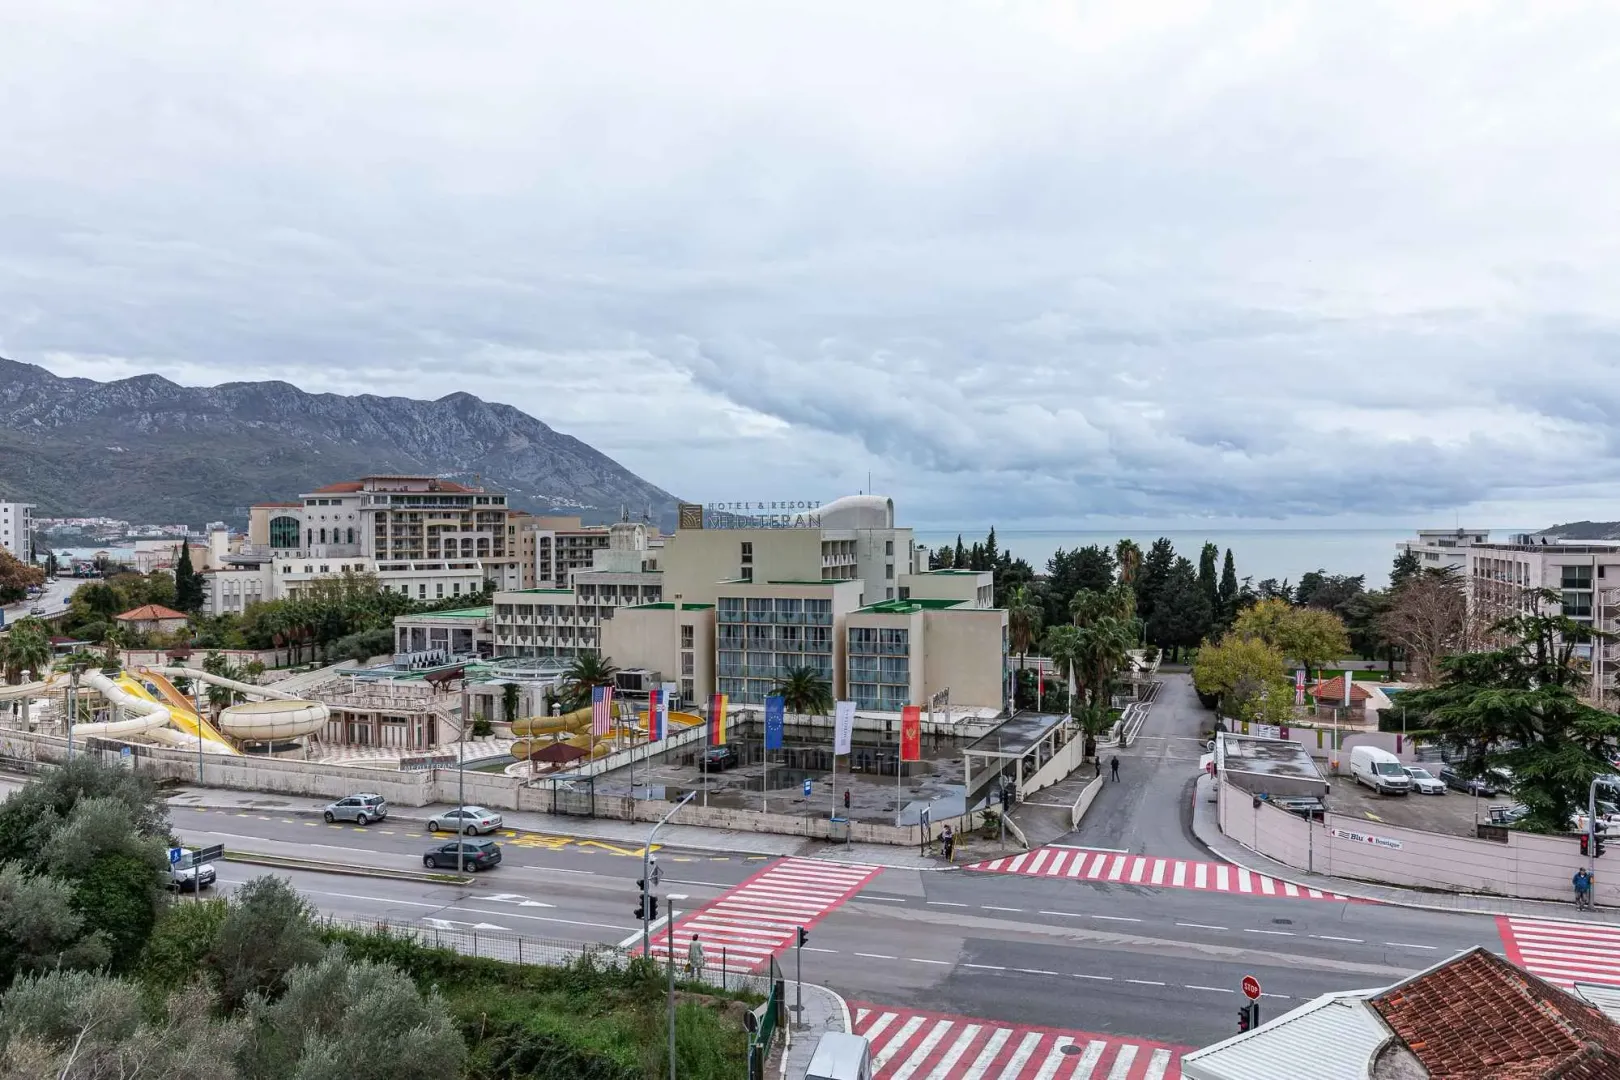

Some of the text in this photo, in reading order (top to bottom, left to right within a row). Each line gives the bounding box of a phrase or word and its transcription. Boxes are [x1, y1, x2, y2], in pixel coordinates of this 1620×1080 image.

[708, 500, 820, 510] HOTEL & RESORT
[709, 514, 821, 528] MEDITERAN
[1350, 833, 1364, 842] Blu
[1243, 982, 1258, 993] STOP
